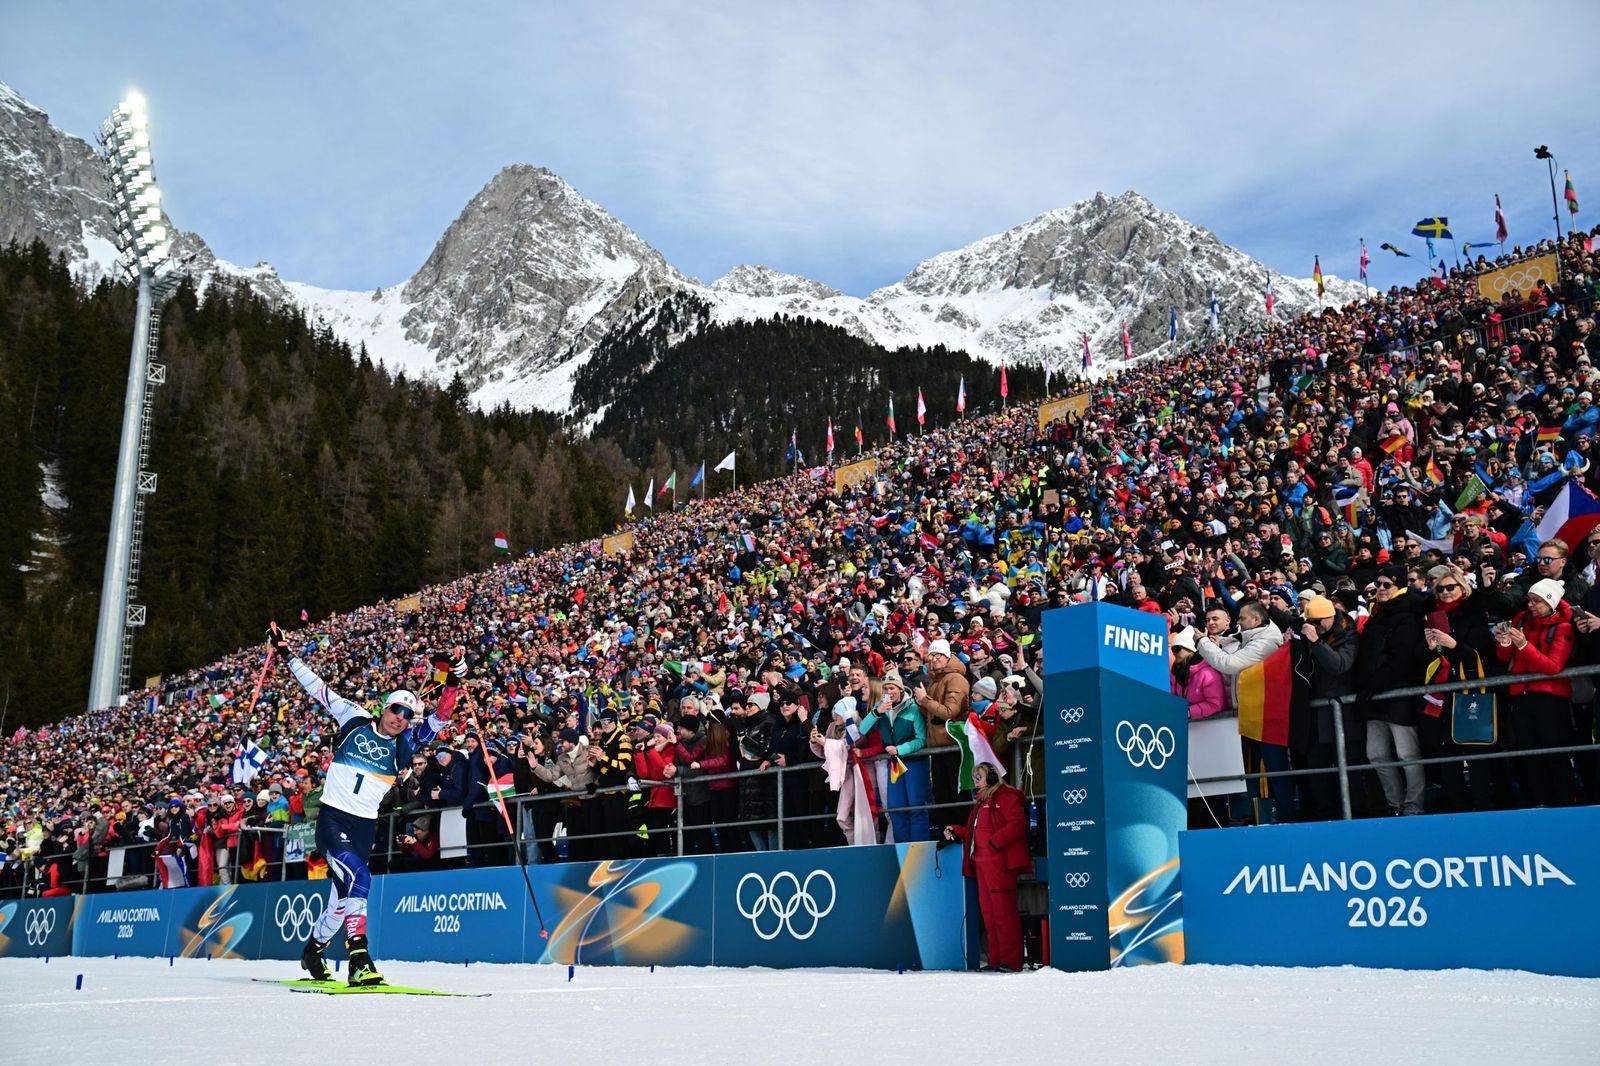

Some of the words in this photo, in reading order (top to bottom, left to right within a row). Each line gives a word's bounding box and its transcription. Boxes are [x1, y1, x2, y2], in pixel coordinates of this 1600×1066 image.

[1104, 624, 1163, 657] FINISH
[353, 772, 365, 795] 1
[1222, 860, 1377, 895] MILANO
[1385, 853, 1577, 890] CORTINA
[394, 893, 447, 913] MILANO
[448, 891, 507, 911] CORTINA
[1347, 896, 1428, 928] 2026
[96, 909, 128, 924] MILANO
[128, 907, 160, 922] CORTINA
[433, 914, 460, 933] 2026
[117, 924, 134, 938] 2026
